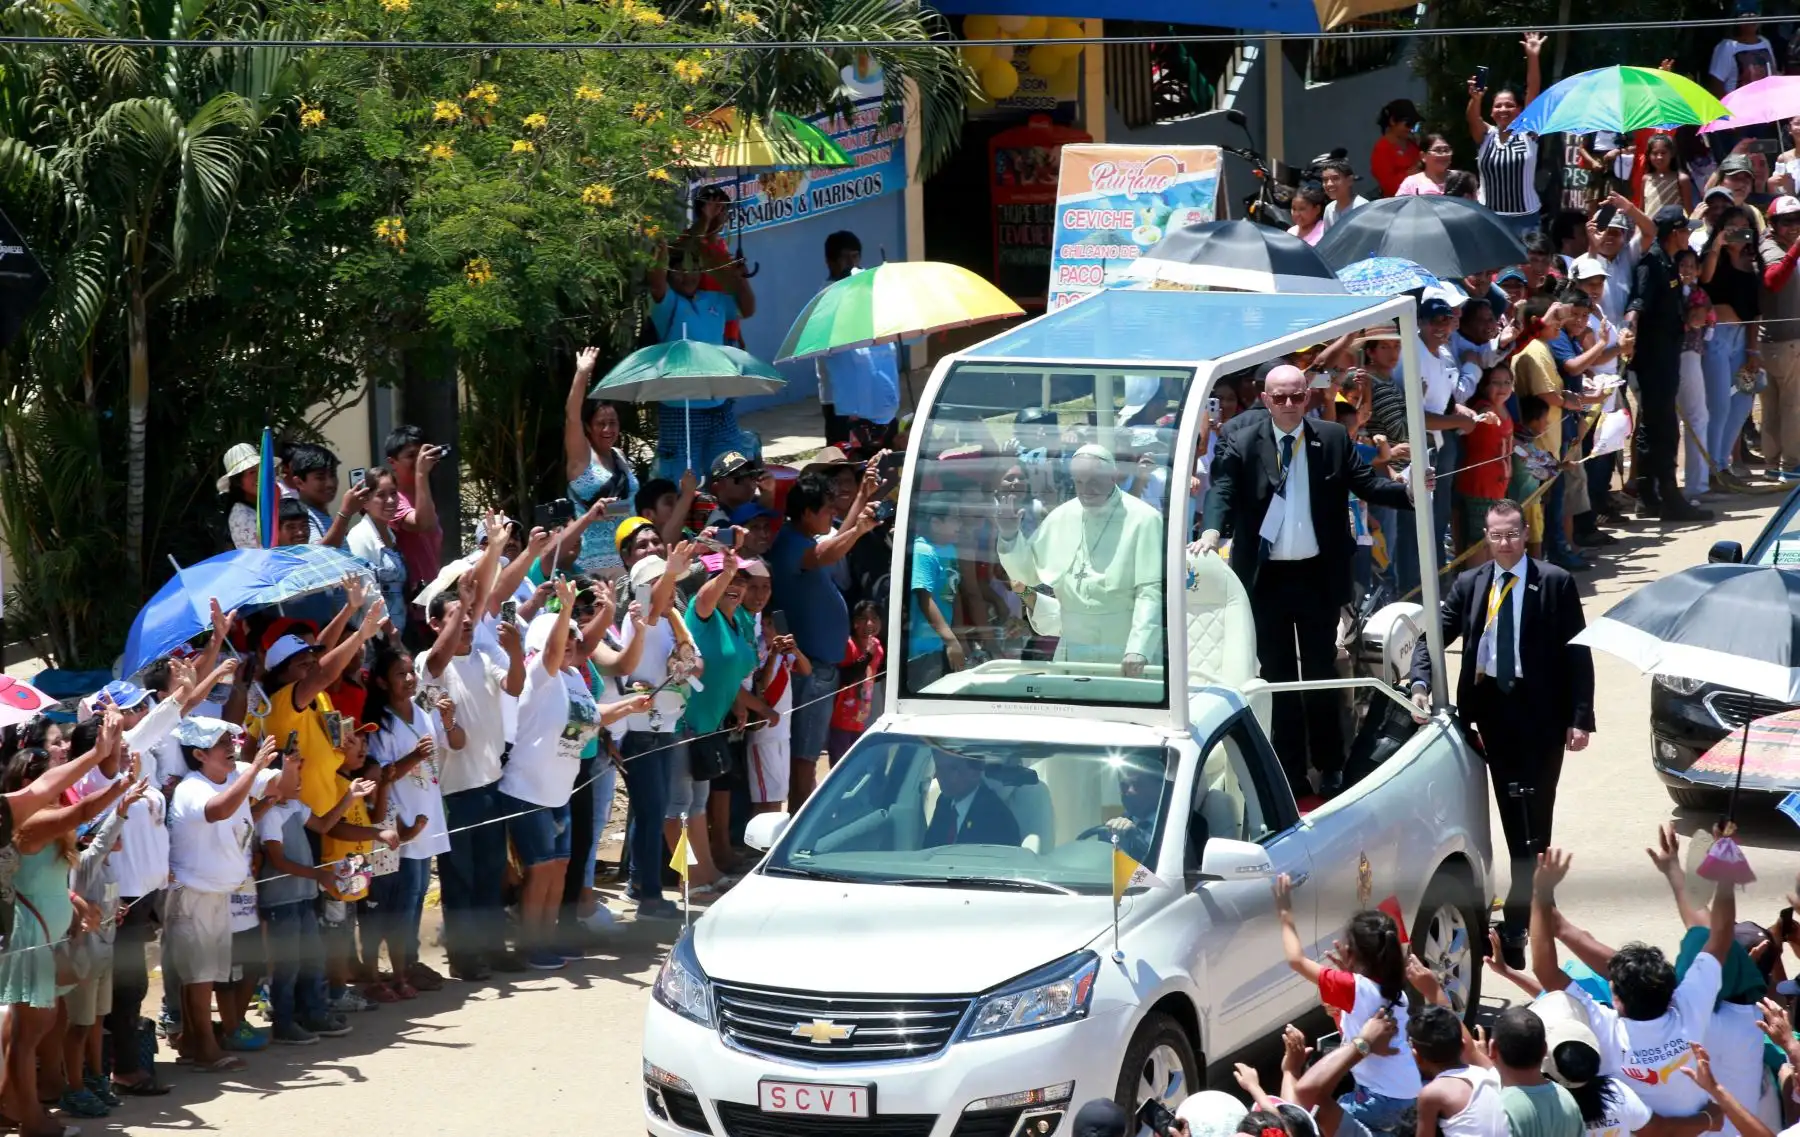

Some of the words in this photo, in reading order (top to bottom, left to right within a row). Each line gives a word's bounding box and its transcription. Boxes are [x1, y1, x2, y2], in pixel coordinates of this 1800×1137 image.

[799, 195, 808, 213] &
[811, 173, 882, 209] MARISCOS
[1064, 210, 1134, 228] CEVICHE
[1061, 246, 1120, 259] CHILCANO
[1121, 246, 1138, 258] DE
[1059, 266, 1104, 284] PACO
[1663, 1038, 1684, 1051] POR
